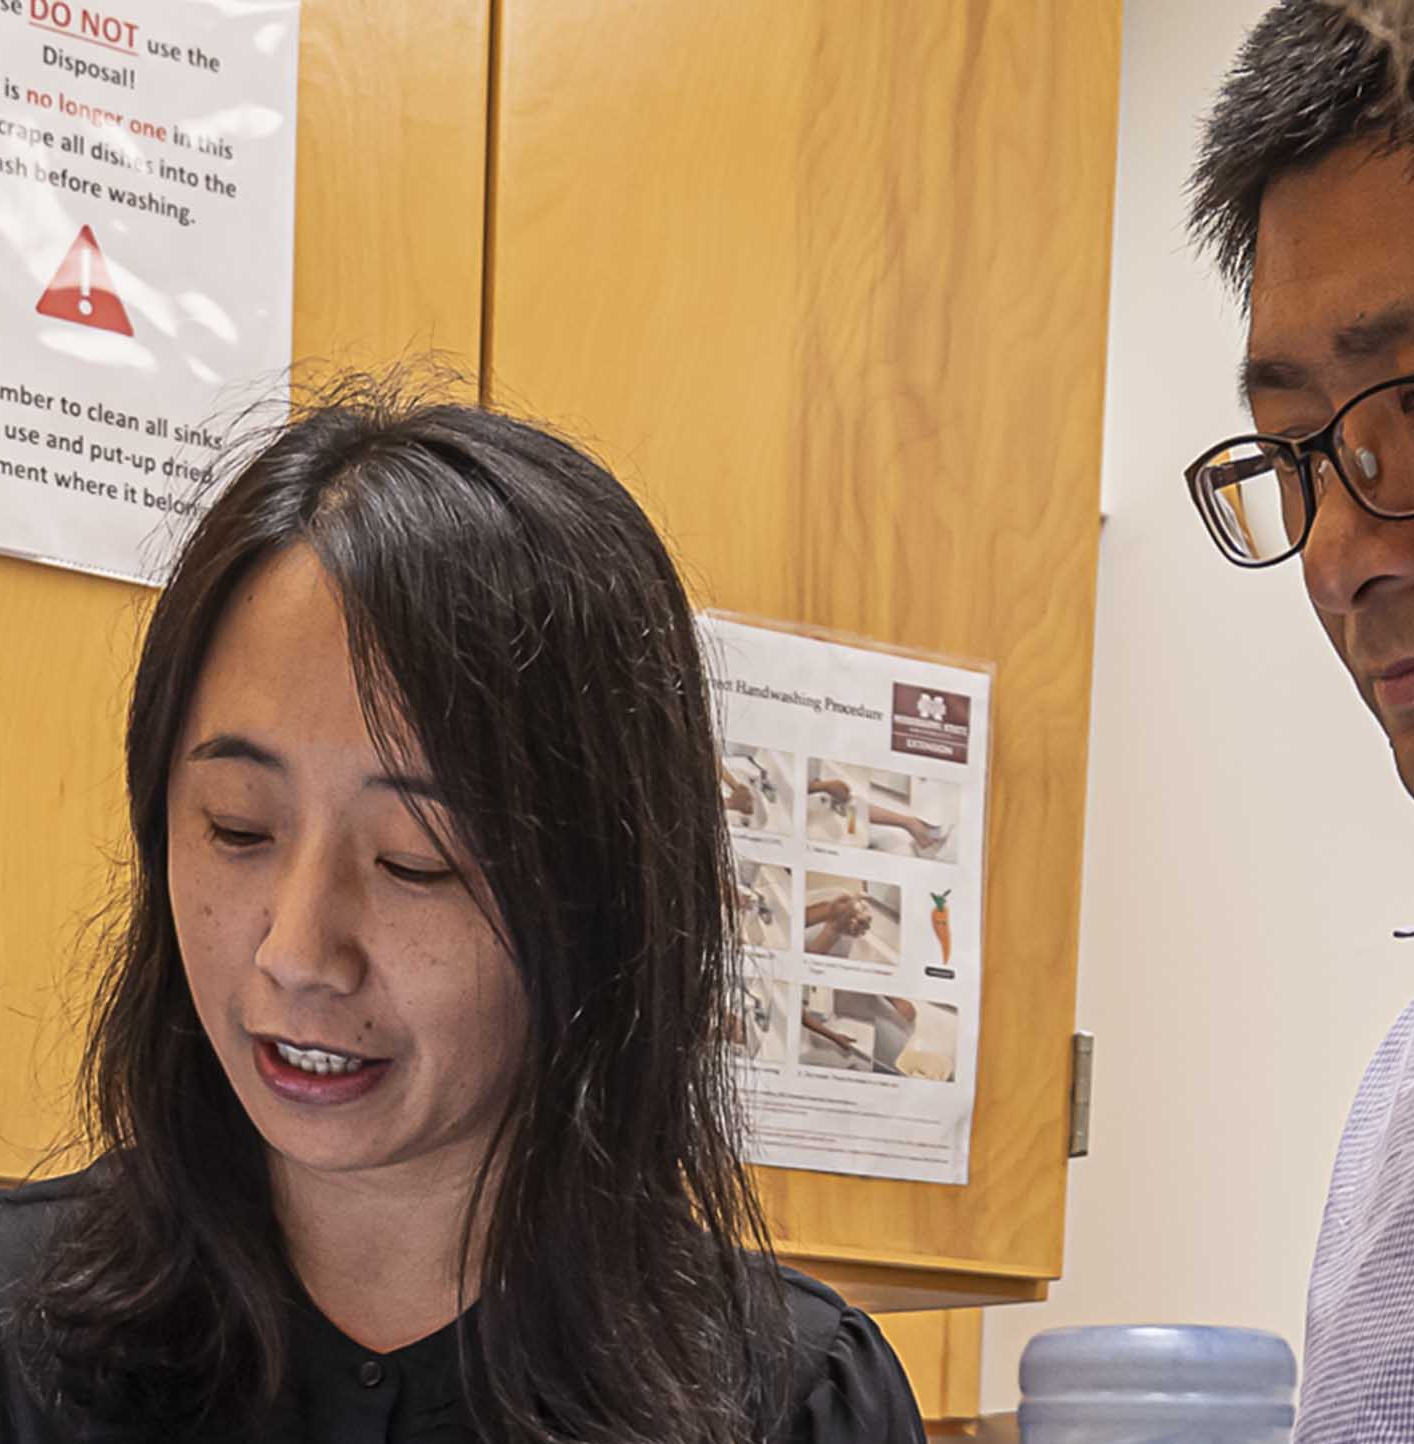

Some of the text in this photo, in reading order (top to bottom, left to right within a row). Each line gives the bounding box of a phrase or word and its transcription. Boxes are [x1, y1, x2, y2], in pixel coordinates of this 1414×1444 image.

[29, 0, 71, 27] DO
[80, 8, 139, 49] NOT
[148, 39, 181, 61] use
[187, 47, 220, 72] the
[43, 45, 136, 89] Disposal!
[5, 79, 20, 101] is
[26, 88, 53, 109] no
[59, 94, 123, 128] longer
[130, 117, 167, 142] one
[173, 126, 191, 148] in
[198, 136, 234, 160] this
[61, 135, 85, 156] all
[159, 161, 199, 188] into
[205, 173, 237, 198] the
[34, 162, 102, 198] before
[108, 185, 196, 227] washing.
[5, 424, 39, 445] use
[47, 433, 83, 455] and
[90, 443, 155, 474] put-up
[61, 397, 81, 418] to
[87, 404, 138, 431] clean
[146, 418, 168, 438] all
[174, 424, 223, 450] sinks
[54, 470, 118, 499] where
[124, 483, 137, 504] it
[143, 488, 202, 517] belon
[736, 679, 822, 714] Handwashing
[824, 697, 884, 722] Procedure
